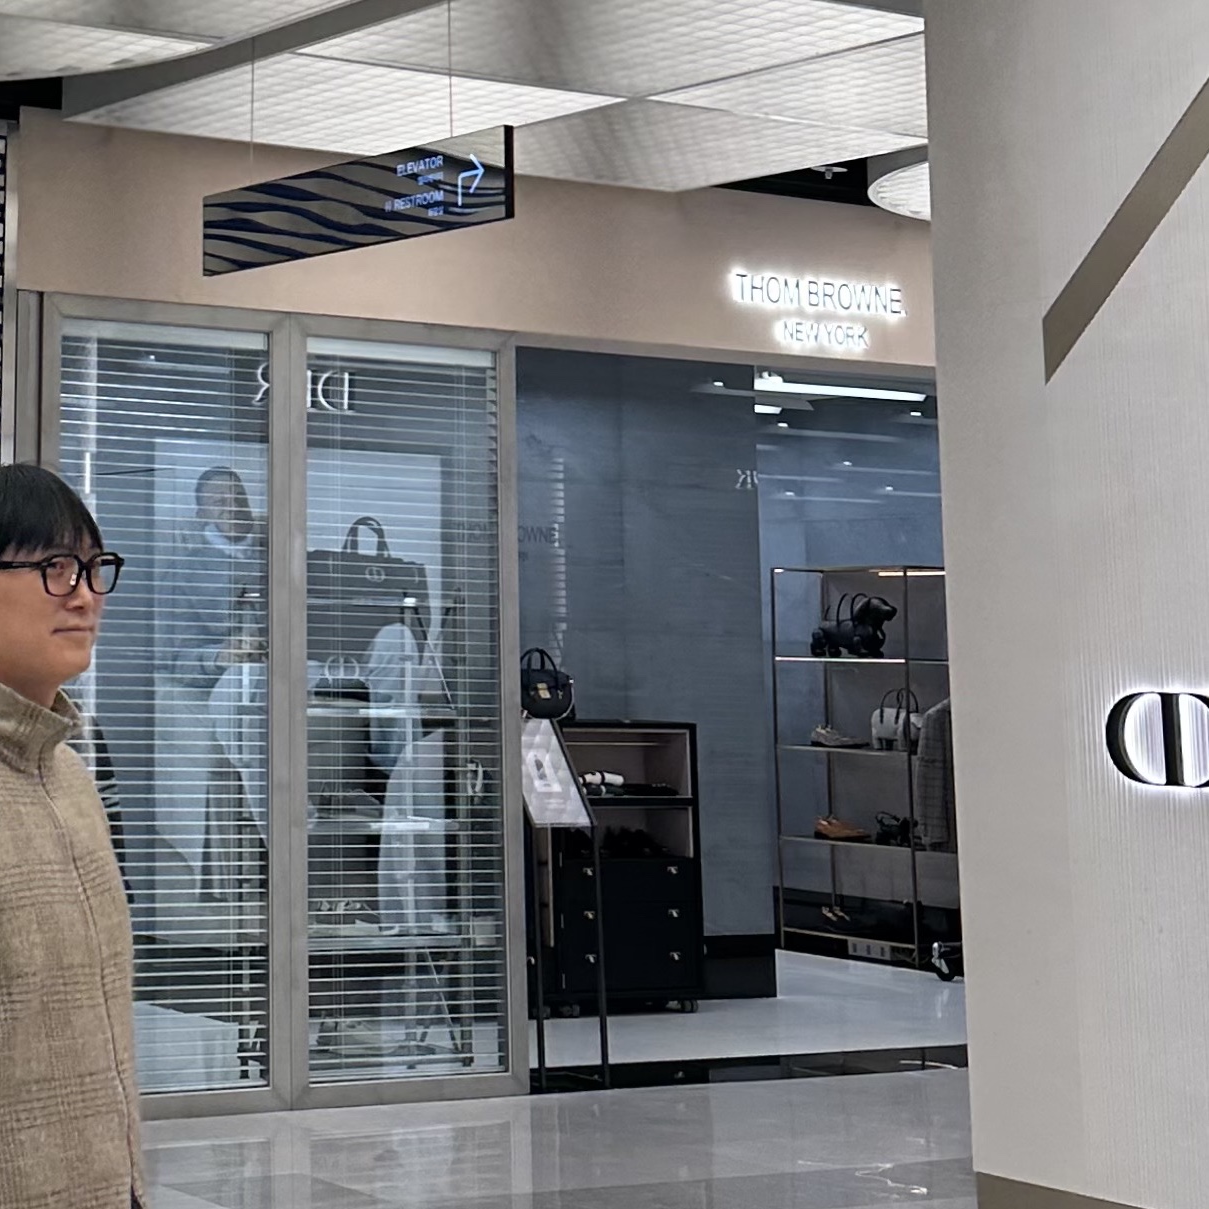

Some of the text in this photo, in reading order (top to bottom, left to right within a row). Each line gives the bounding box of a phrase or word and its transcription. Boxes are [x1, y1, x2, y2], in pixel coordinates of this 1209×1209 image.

[396, 155, 443, 176] ELEVATOR
[394, 190, 443, 211] RESTROOM
[735, 273, 800, 306] THOM
[783, 321, 870, 347] NEW YORK
